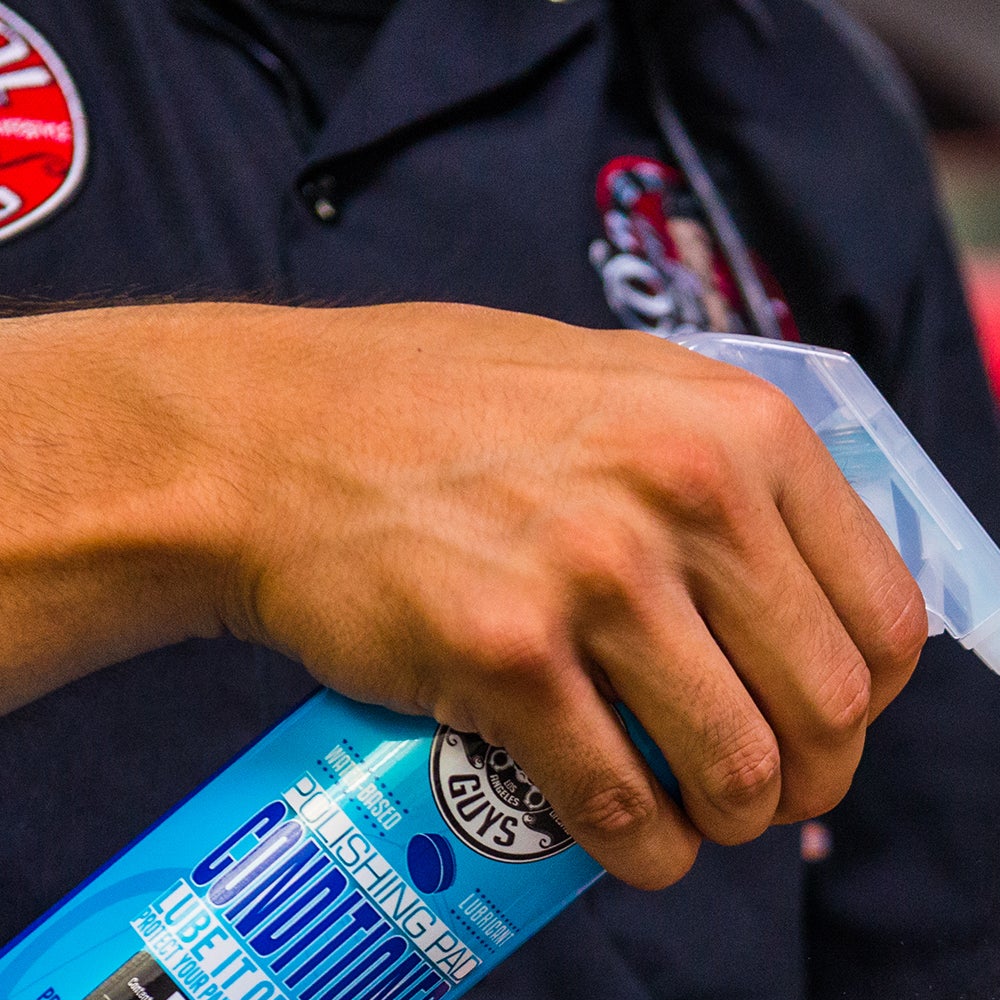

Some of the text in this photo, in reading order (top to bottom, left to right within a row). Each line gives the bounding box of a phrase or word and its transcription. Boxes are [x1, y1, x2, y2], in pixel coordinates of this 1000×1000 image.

[448, 774, 518, 846] GUYS
[490, 774, 520, 806] ANGELES
[503, 779, 517, 793] LOS
[293, 776, 480, 981] POLISHING PAD
[136, 908, 183, 961] PROTECT
[174, 951, 210, 993] YOUR
[152, 881, 228, 961] LUBE
[211, 948, 257, 990] IT
[458, 893, 514, 947] LUBRICANT
